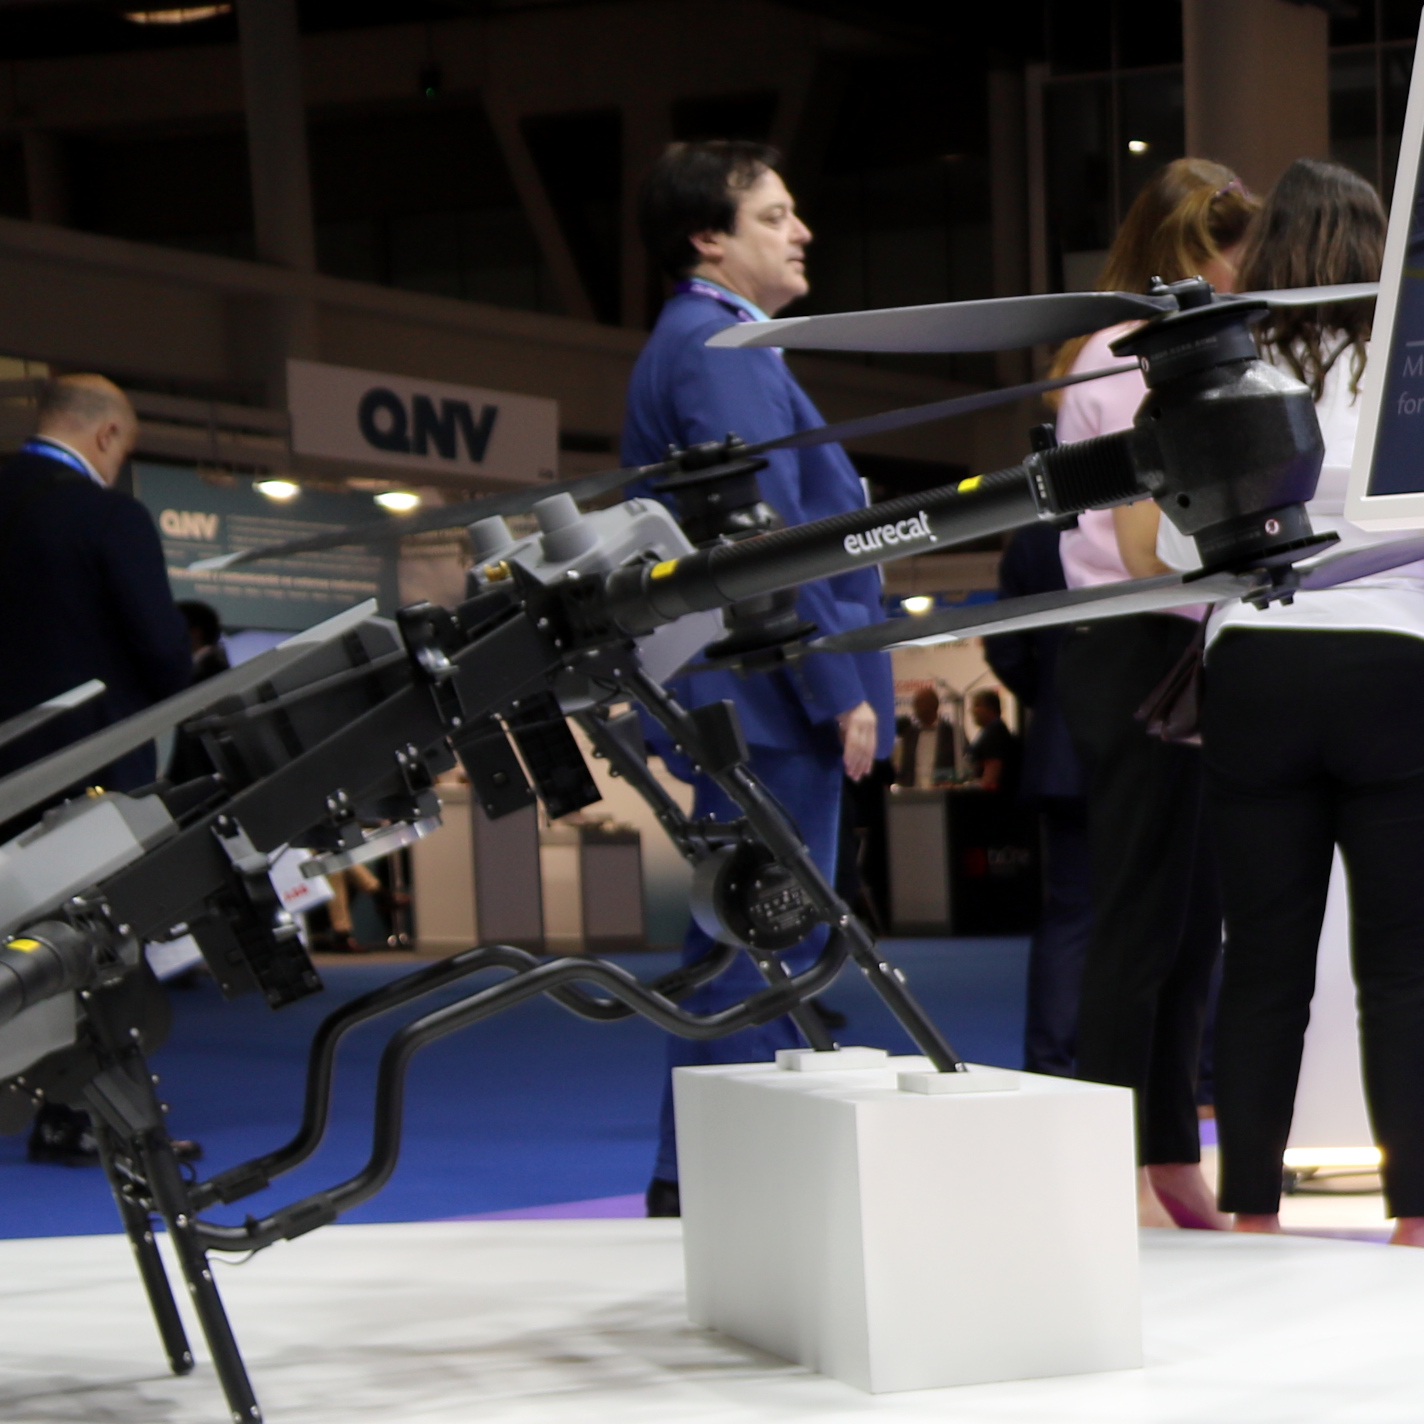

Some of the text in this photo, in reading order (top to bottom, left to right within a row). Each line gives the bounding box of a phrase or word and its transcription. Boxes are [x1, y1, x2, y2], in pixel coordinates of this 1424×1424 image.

[1398, 392, 1424, 414] for
[358, 387, 498, 463] QNV
[844, 511, 937, 554] eurecat
